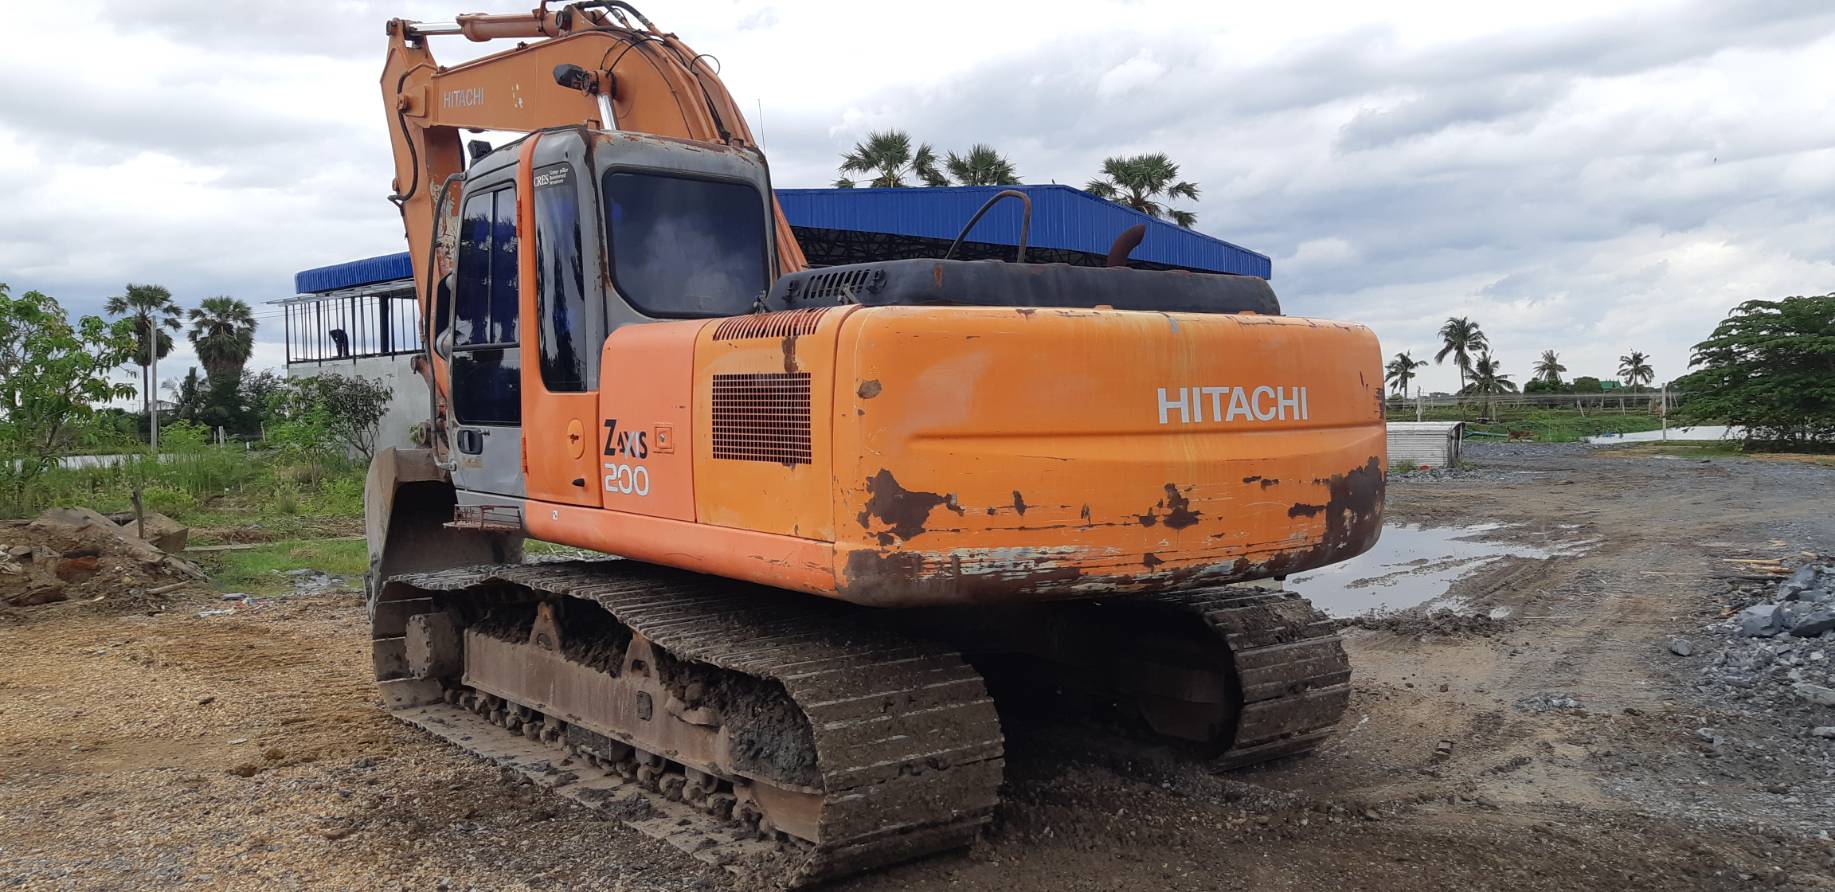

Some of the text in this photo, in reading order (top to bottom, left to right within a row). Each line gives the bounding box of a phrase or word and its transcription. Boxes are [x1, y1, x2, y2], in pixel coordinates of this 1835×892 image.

[443, 88, 484, 109] HITACHI
[1157, 385, 1309, 425] HITACHI
[604, 419, 648, 459] ZAXIS
[604, 463, 650, 496] 200
